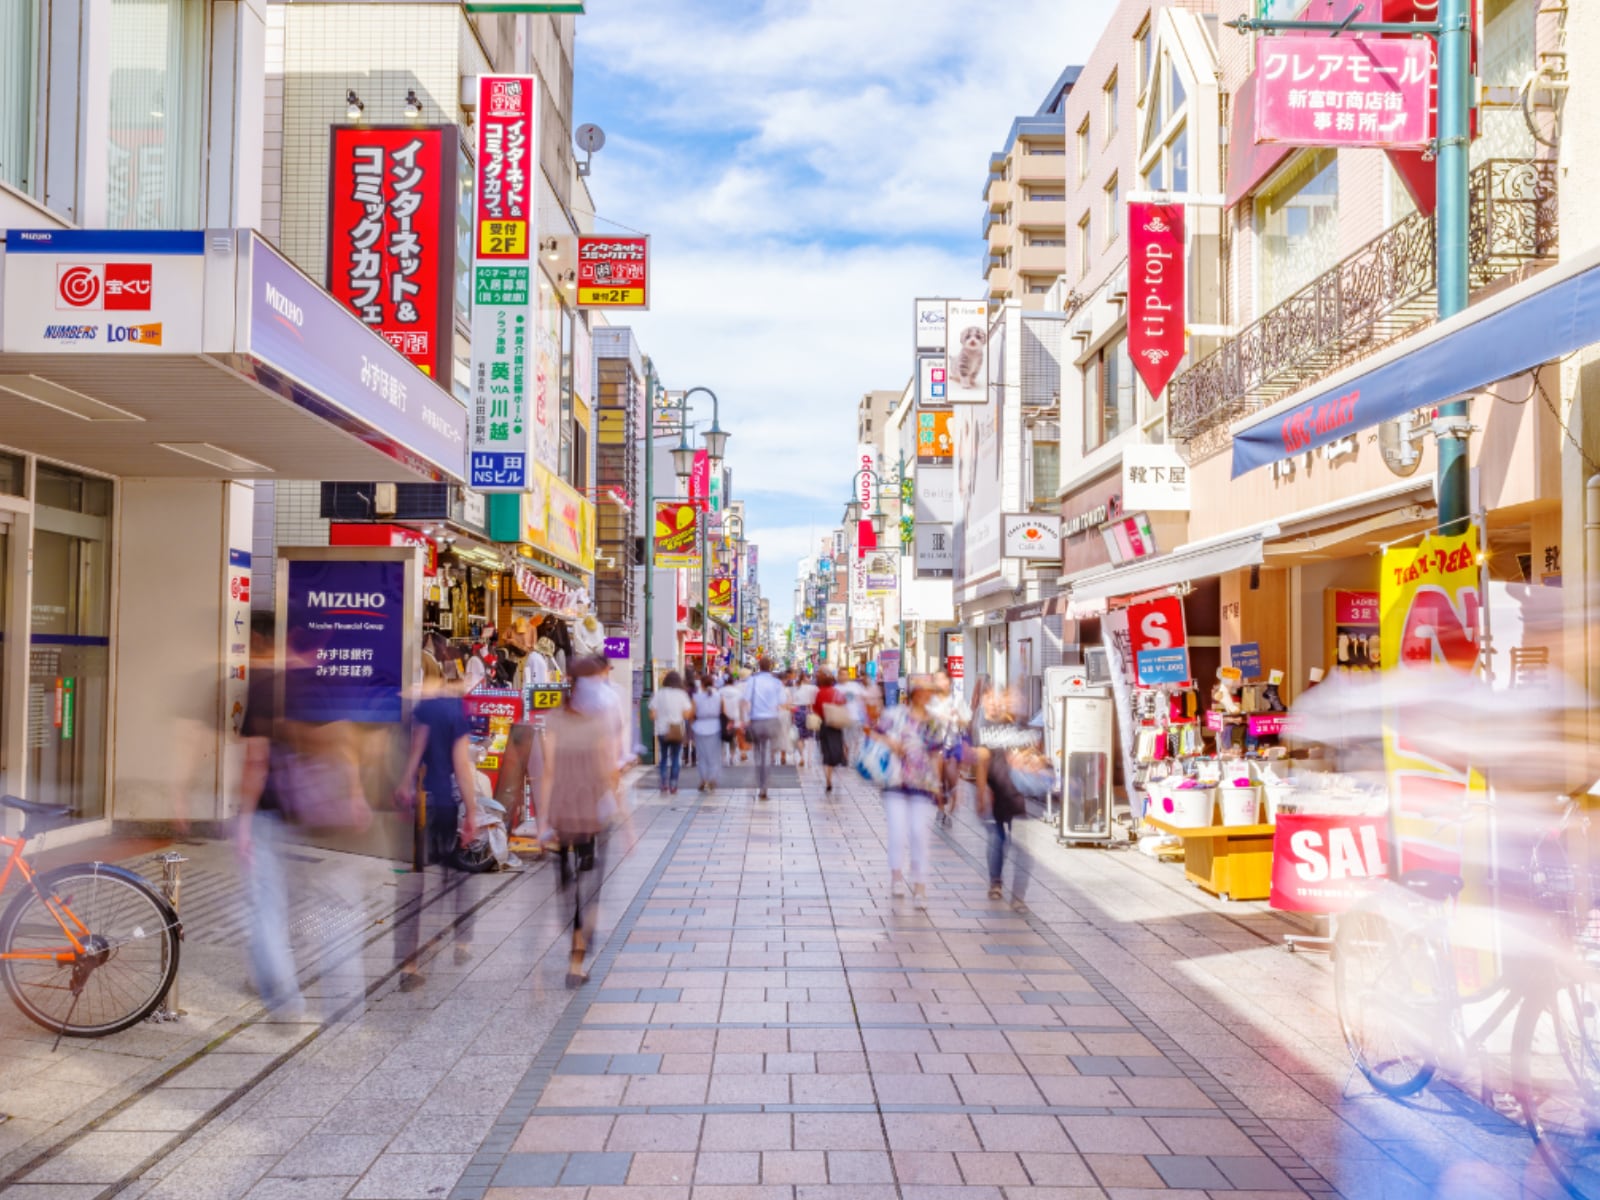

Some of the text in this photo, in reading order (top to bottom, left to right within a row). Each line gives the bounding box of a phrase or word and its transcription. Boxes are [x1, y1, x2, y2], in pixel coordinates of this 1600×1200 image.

[1266, 53, 1426, 84] クレアモール
[1288, 89, 1403, 110] 新富町商店街
[1313, 112, 1378, 132] 事務所
[484, 123, 503, 218] コミックカフェ
[506, 119, 525, 217] インターネット&
[21, 232, 52, 240] MIZUHO
[350, 146, 385, 324] コミックカフェ
[389, 138, 423, 323] インターネット&
[489, 223, 517, 235] 受付
[490, 237, 516, 253] 2F
[105, 279, 150, 295] 宝くじ
[265, 281, 305, 327] MIZUHO
[43, 324, 98, 341] NUMBERS
[107, 323, 140, 343] LOTO
[360, 354, 408, 413] みずほ銀行
[1281, 389, 1361, 454] ABC-MART
[474, 471, 521, 483] NSビル
[861, 455, 873, 511] docomo
[1130, 466, 1186, 484] 靴下屋
[307, 591, 386, 608] MIZUHO
[308, 622, 384, 632] Mizuho Financial Group
[316, 648, 374, 661] みずほ銀行
[316, 665, 374, 677] みずほ証券
[538, 692, 559, 705] 2F
